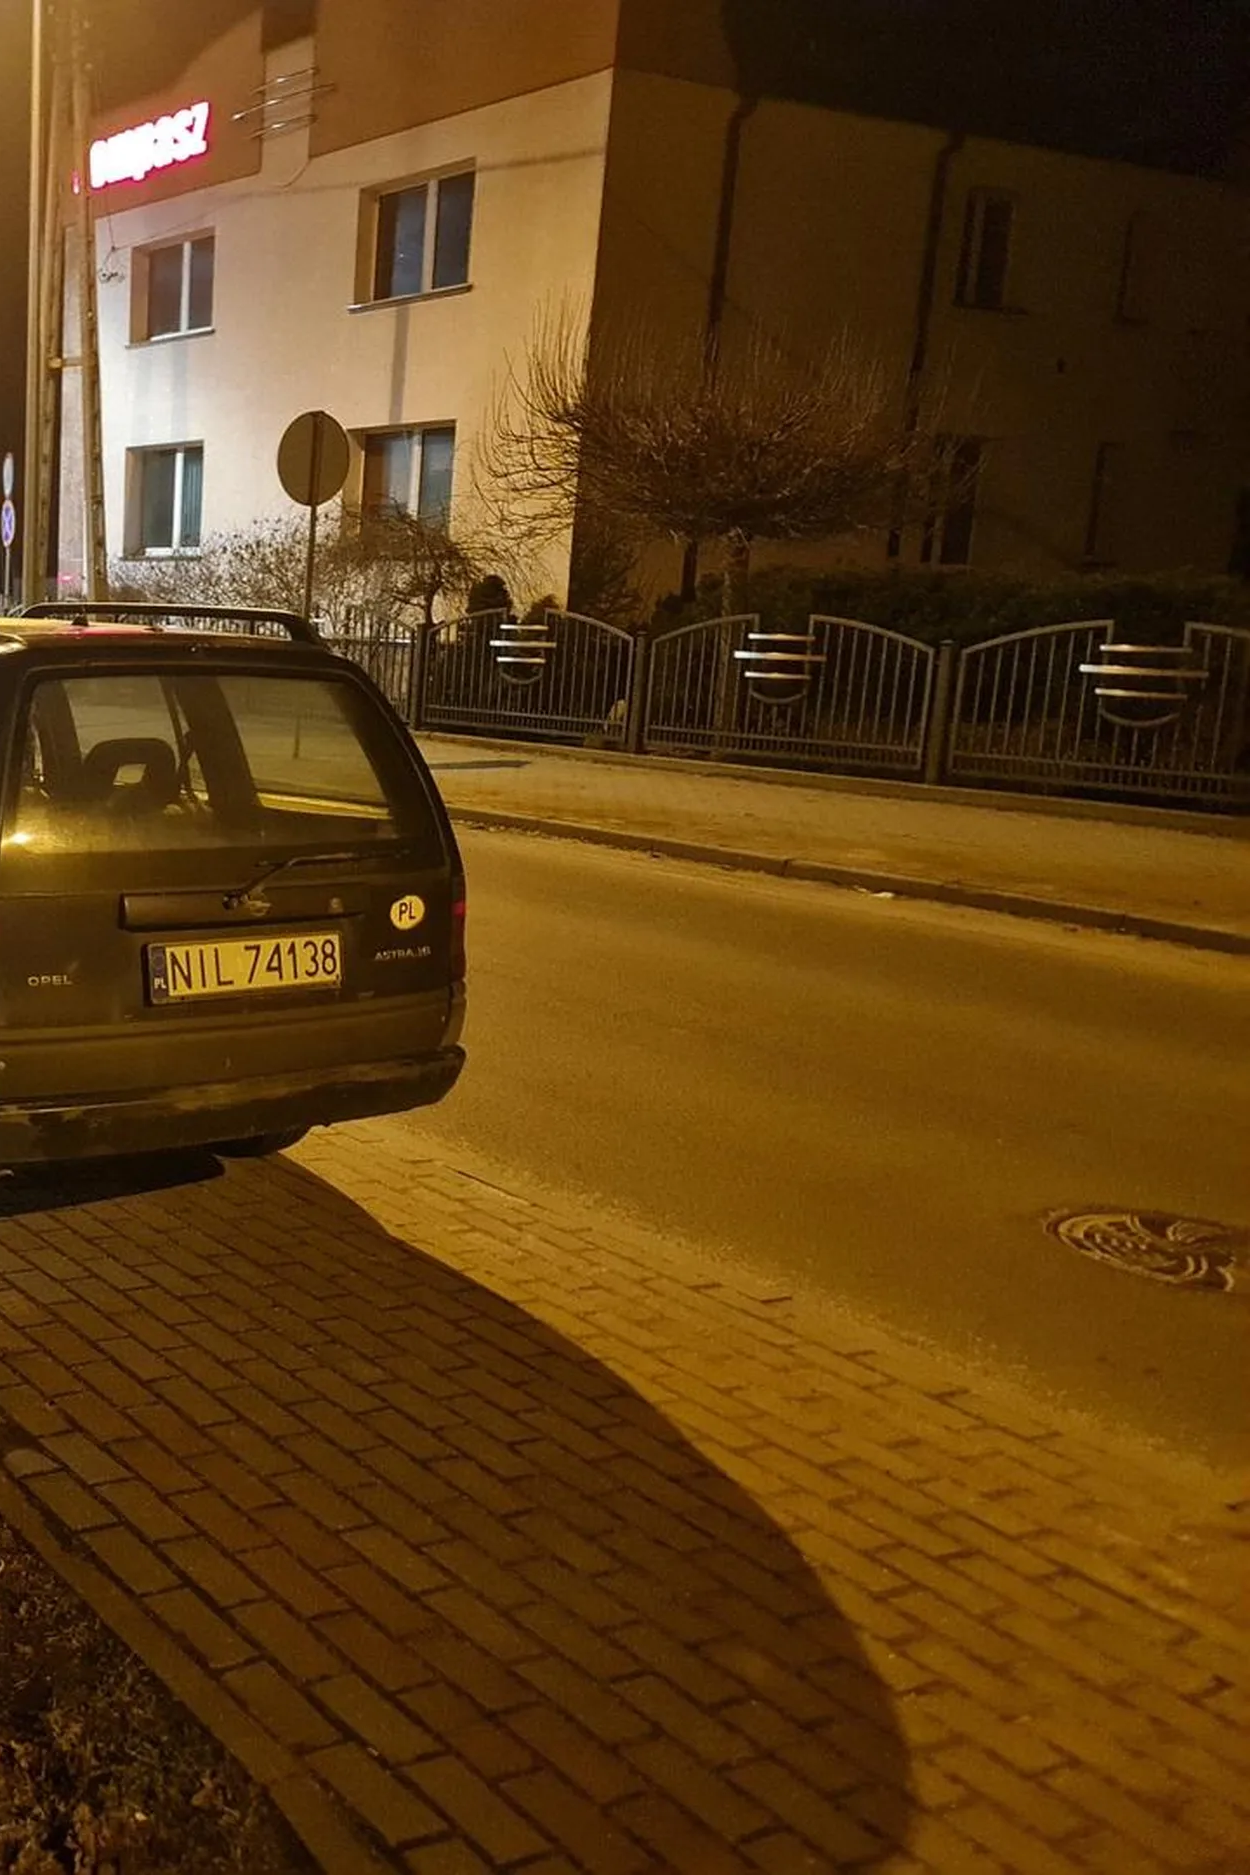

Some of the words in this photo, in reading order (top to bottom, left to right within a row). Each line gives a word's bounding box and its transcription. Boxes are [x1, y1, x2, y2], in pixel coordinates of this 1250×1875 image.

[398, 901, 417, 921] PL
[374, 948, 415, 961] ASTRA
[170, 947, 234, 990] NIL
[244, 939, 338, 984] 74138
[27, 974, 73, 986] OPEL
[154, 977, 167, 989] PL
